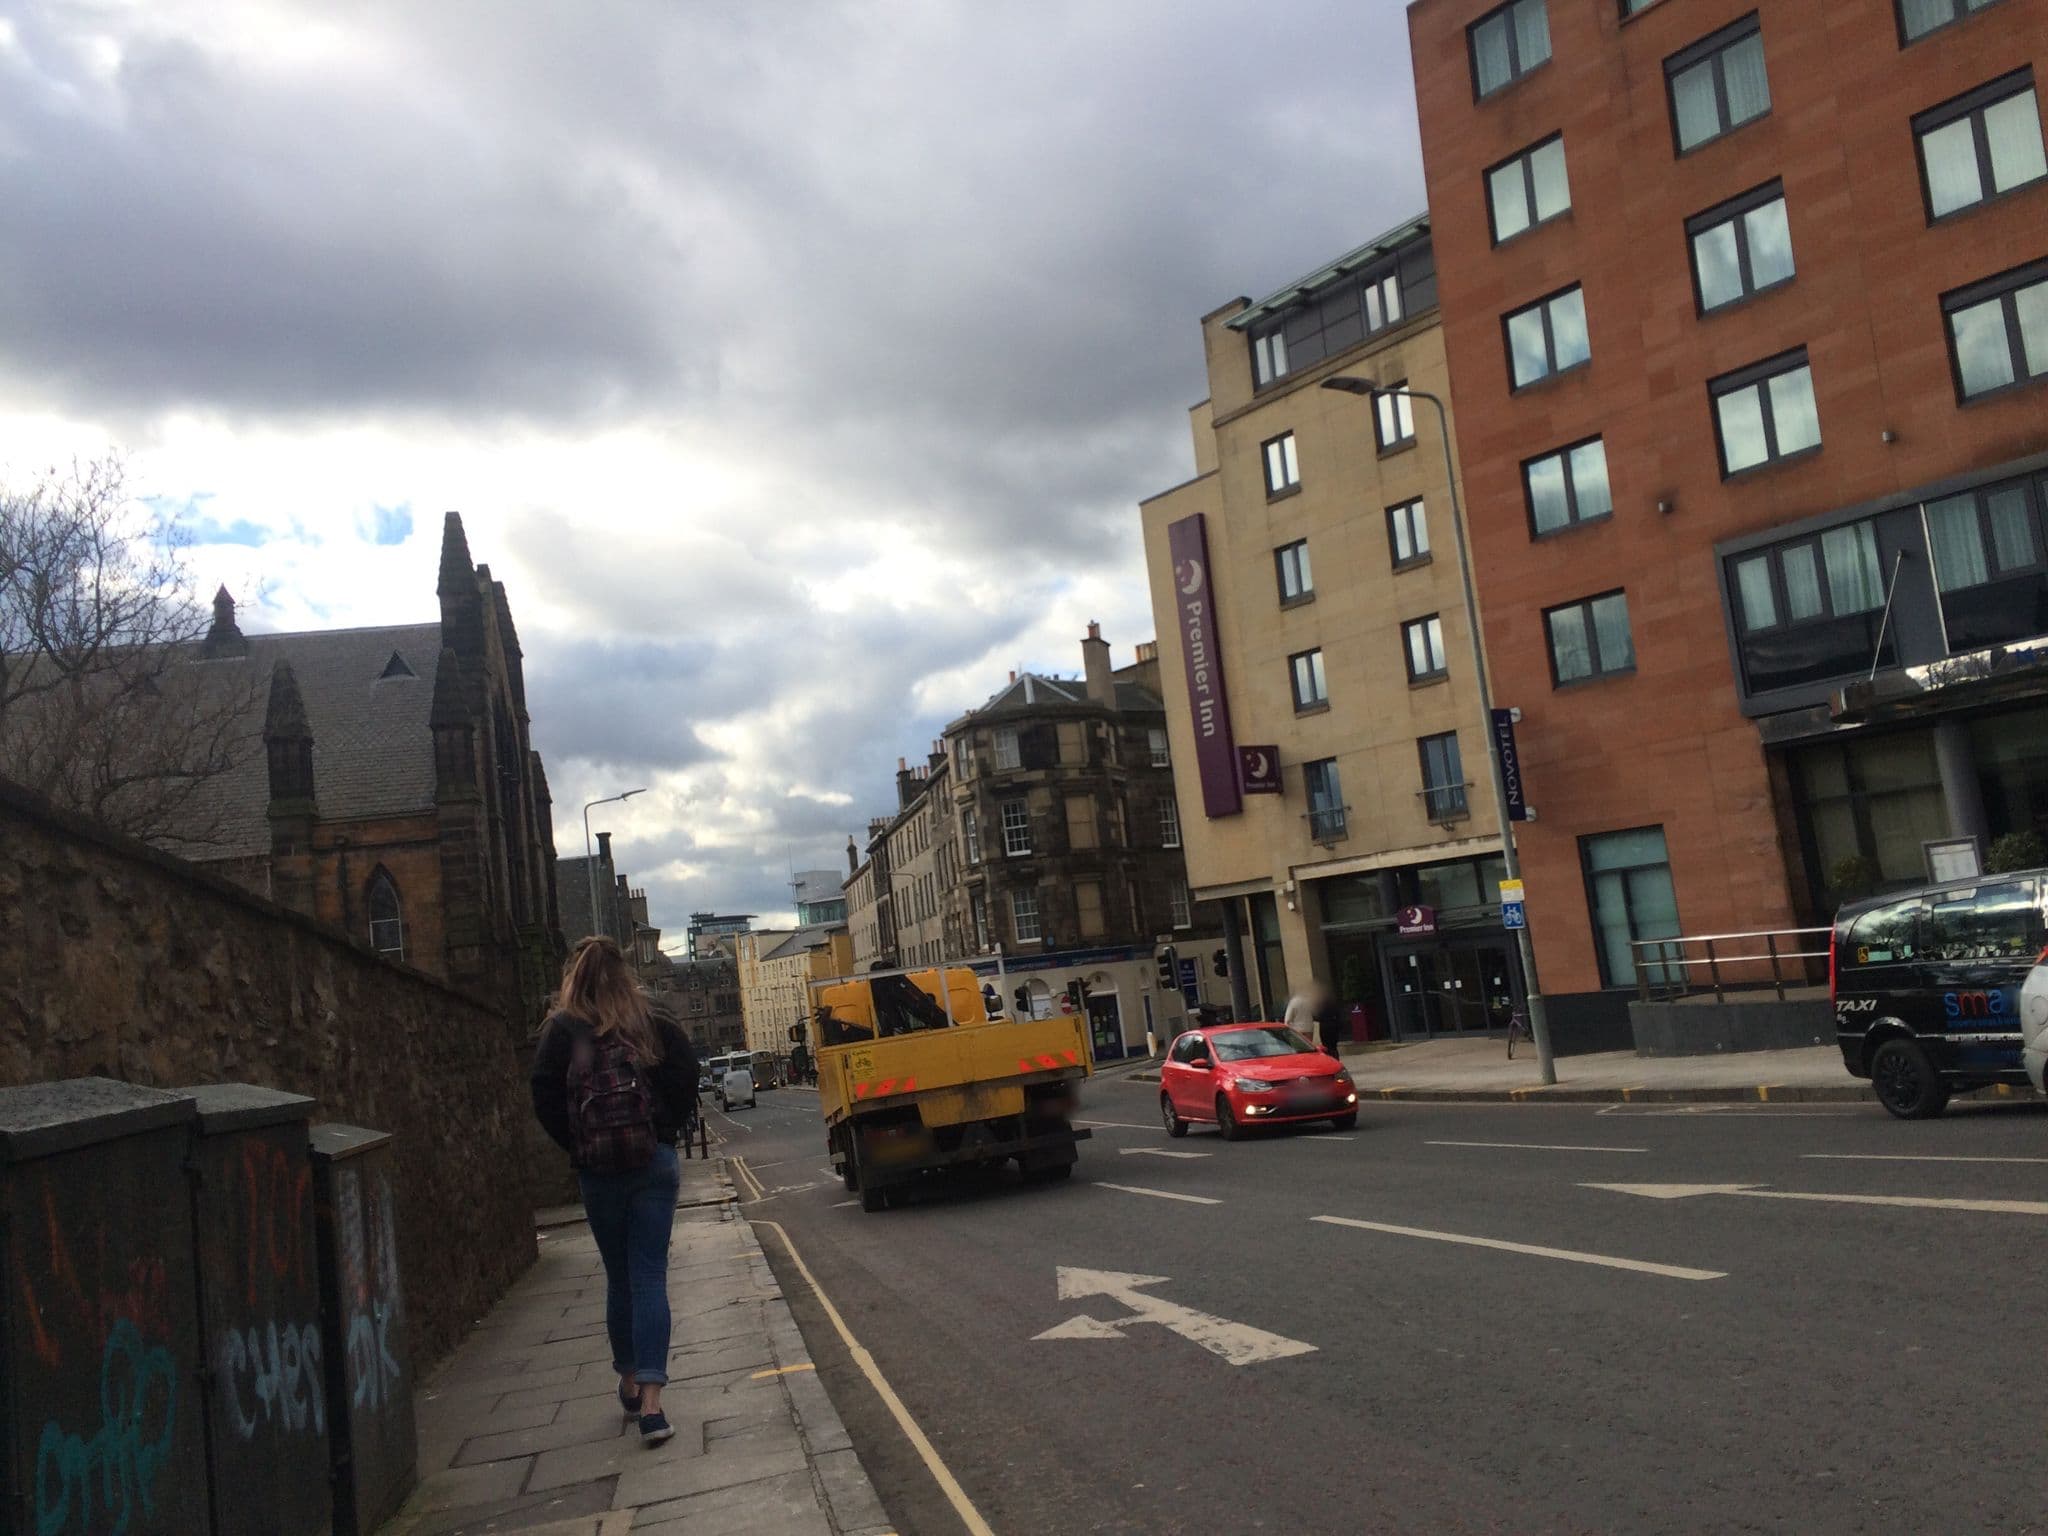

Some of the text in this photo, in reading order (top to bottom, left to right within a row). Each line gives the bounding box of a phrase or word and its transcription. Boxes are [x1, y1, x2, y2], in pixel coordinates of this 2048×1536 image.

[1187, 601, 1216, 737] Premier Inn
[1497, 716, 1519, 805] NOVOTEL
[1836, 999, 1877, 1012] TAXI
